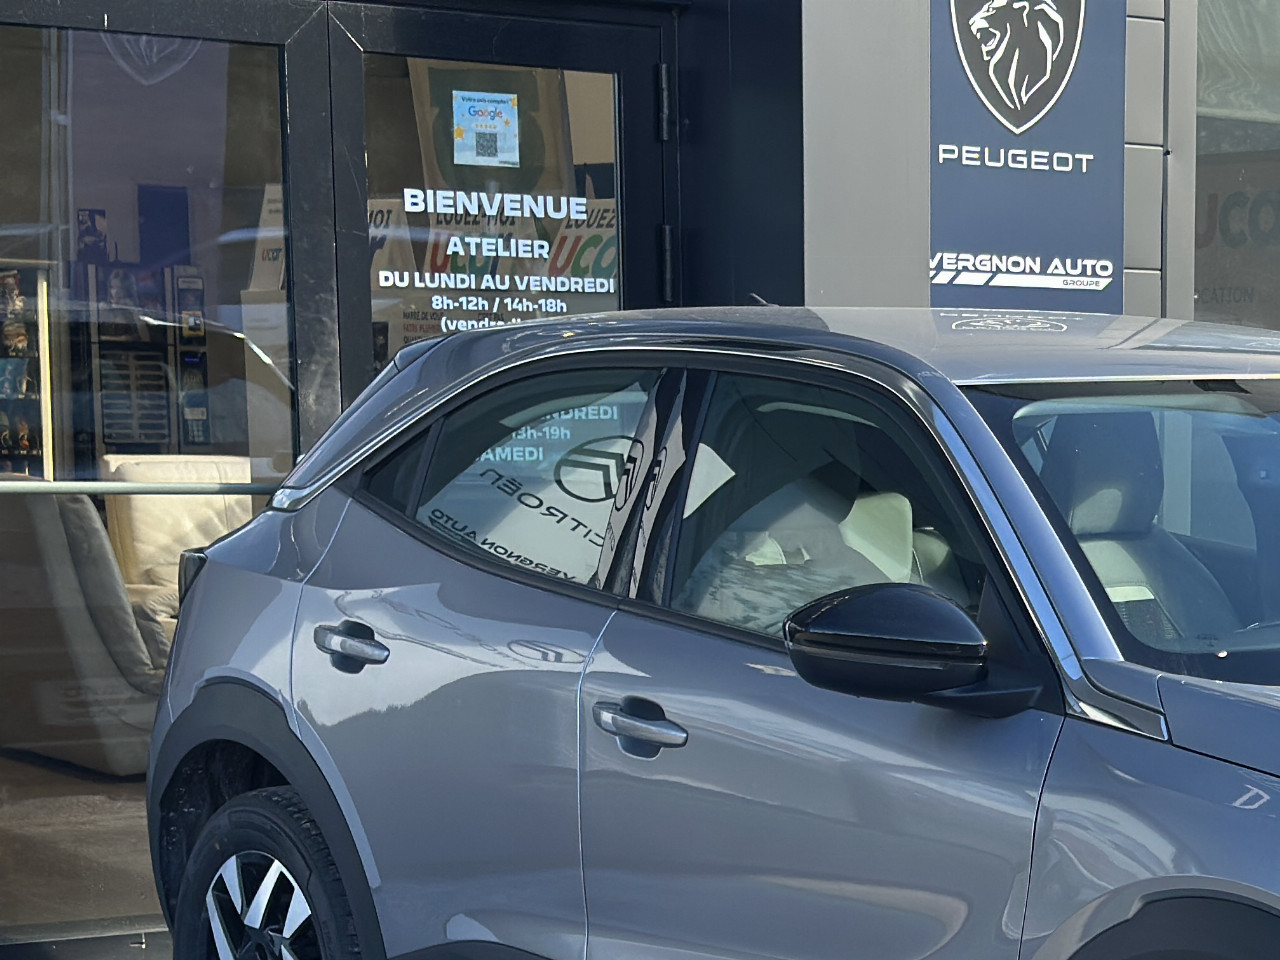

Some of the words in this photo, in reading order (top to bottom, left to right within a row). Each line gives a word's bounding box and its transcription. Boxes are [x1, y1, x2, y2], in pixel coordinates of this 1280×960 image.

[468, 106, 503, 120] Google
[939, 144, 1094, 173] PEUGEOT
[403, 188, 587, 220] BIENVENUE
[446, 236, 550, 259] ATELIER
[930, 252, 1041, 274] VERGNON
[1047, 257, 1113, 277] AUTO
[379, 270, 409, 287] DU
[414, 271, 476, 289] LUNDI
[481, 273, 511, 291] AU
[514, 275, 615, 294] VENDREDI
[1062, 279, 1101, 287] GROUPE
[431, 295, 489, 311] 8h-12h
[504, 297, 567, 313] 14h-18h
[476, 447, 544, 462] AMEDI
